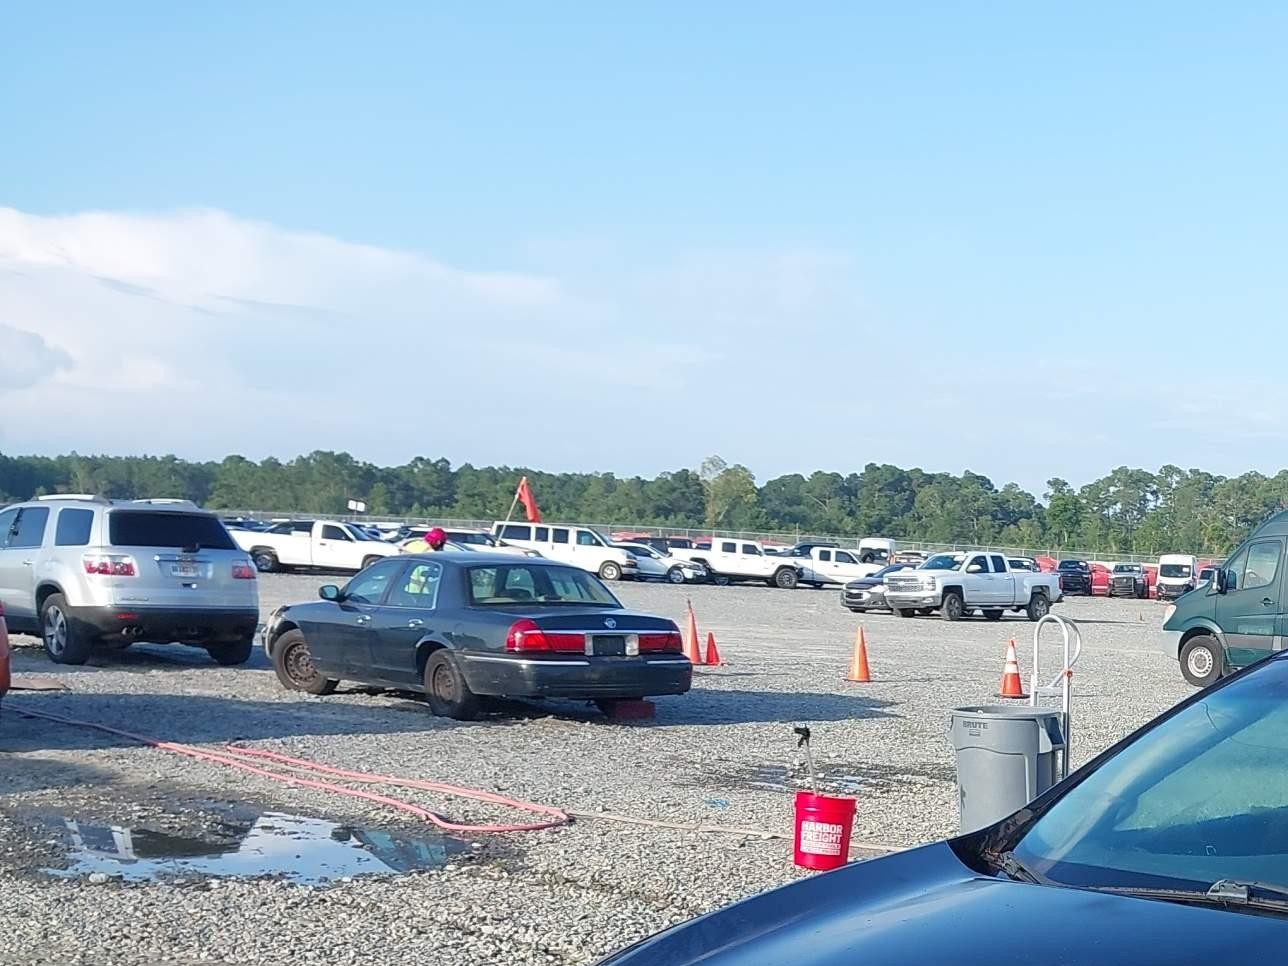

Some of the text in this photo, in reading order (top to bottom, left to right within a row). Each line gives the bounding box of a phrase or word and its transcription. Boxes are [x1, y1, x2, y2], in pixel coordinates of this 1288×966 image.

[962, 720, 989, 729] BRUTE
[801, 820, 843, 834] HARBOR
[801, 830, 842, 843] FREIGHT
